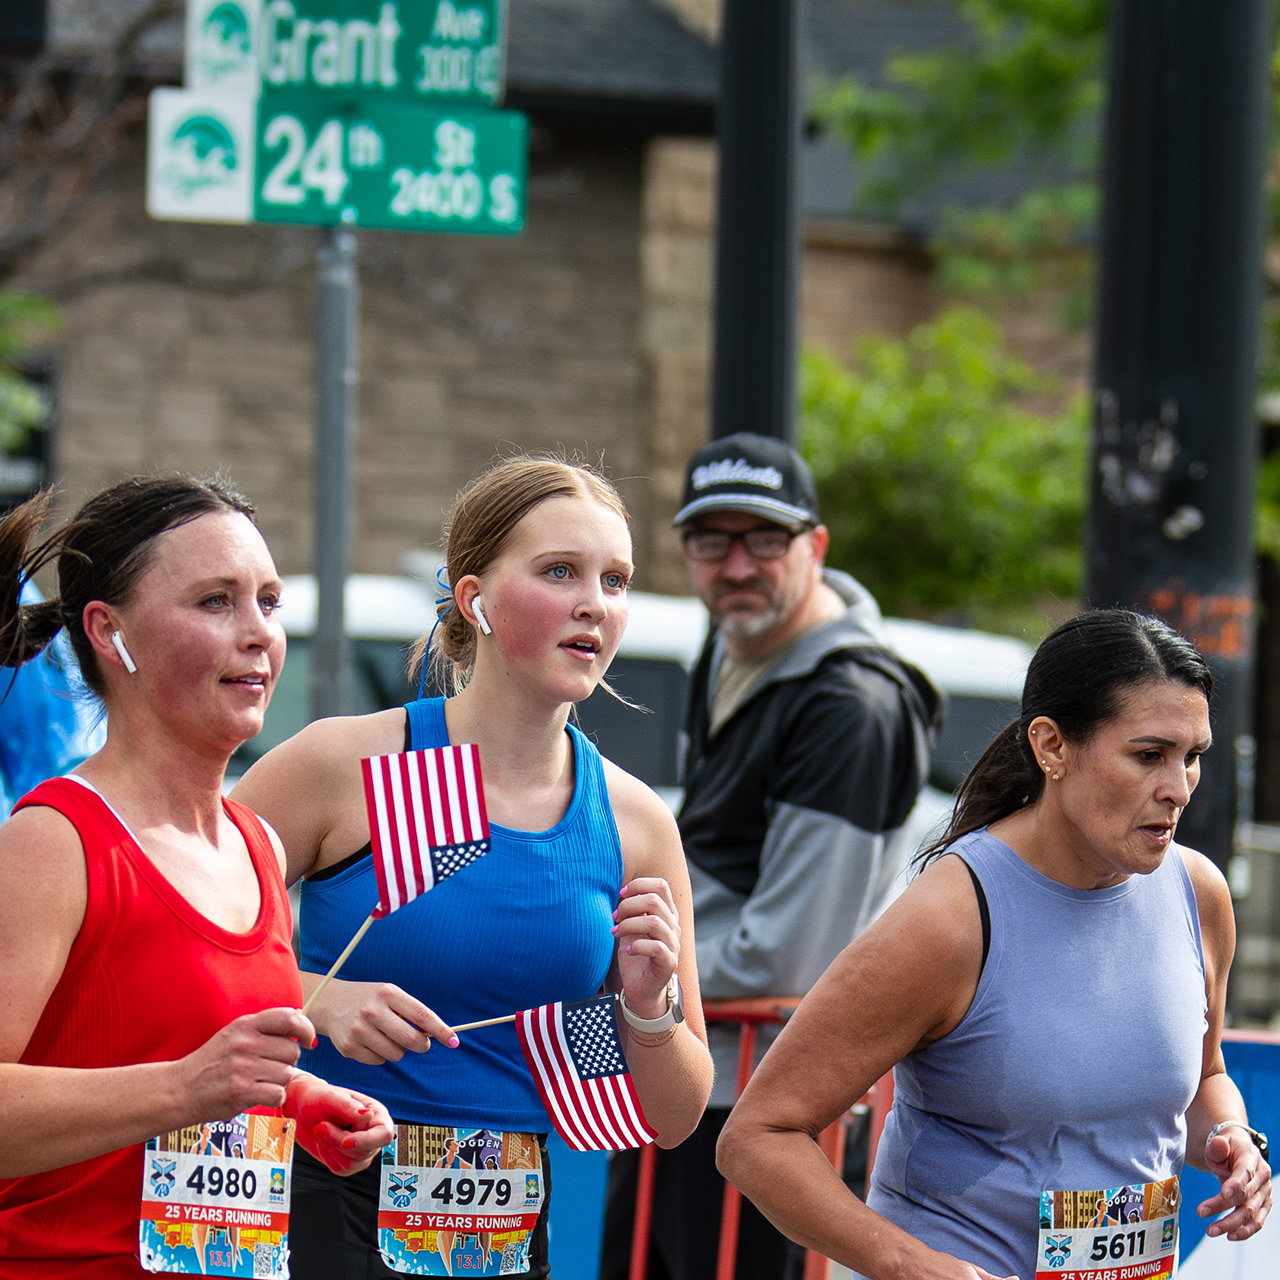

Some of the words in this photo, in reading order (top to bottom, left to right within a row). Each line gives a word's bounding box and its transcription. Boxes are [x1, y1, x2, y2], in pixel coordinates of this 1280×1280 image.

[432, 0, 485, 41] Ave
[263, 0, 402, 87] Grant
[434, 119, 477, 168] St
[261, 114, 384, 205] 24th
[390, 168, 483, 220] 2400
[488, 173, 519, 224] S
[211, 1123, 246, 1136] OGDEN
[458, 1139, 500, 1148] OGDEN
[186, 1165, 257, 1199] 4980
[430, 1177, 511, 1206] 4979
[1108, 1195, 1142, 1207] OGDEN
[165, 1205, 180, 1219] 25
[184, 1207, 223, 1222] YEARS
[225, 1210, 272, 1227] RUNNING
[405, 1214, 423, 1226] 25
[427, 1215, 472, 1228] YEARS
[476, 1216, 522, 1229] RUNNING
[1090, 1229, 1146, 1261] 5611
[210, 1250, 231, 1267] 13.1
[456, 1255, 482, 1269] 13.1
[1120, 1261, 1161, 1280] RUNNING
